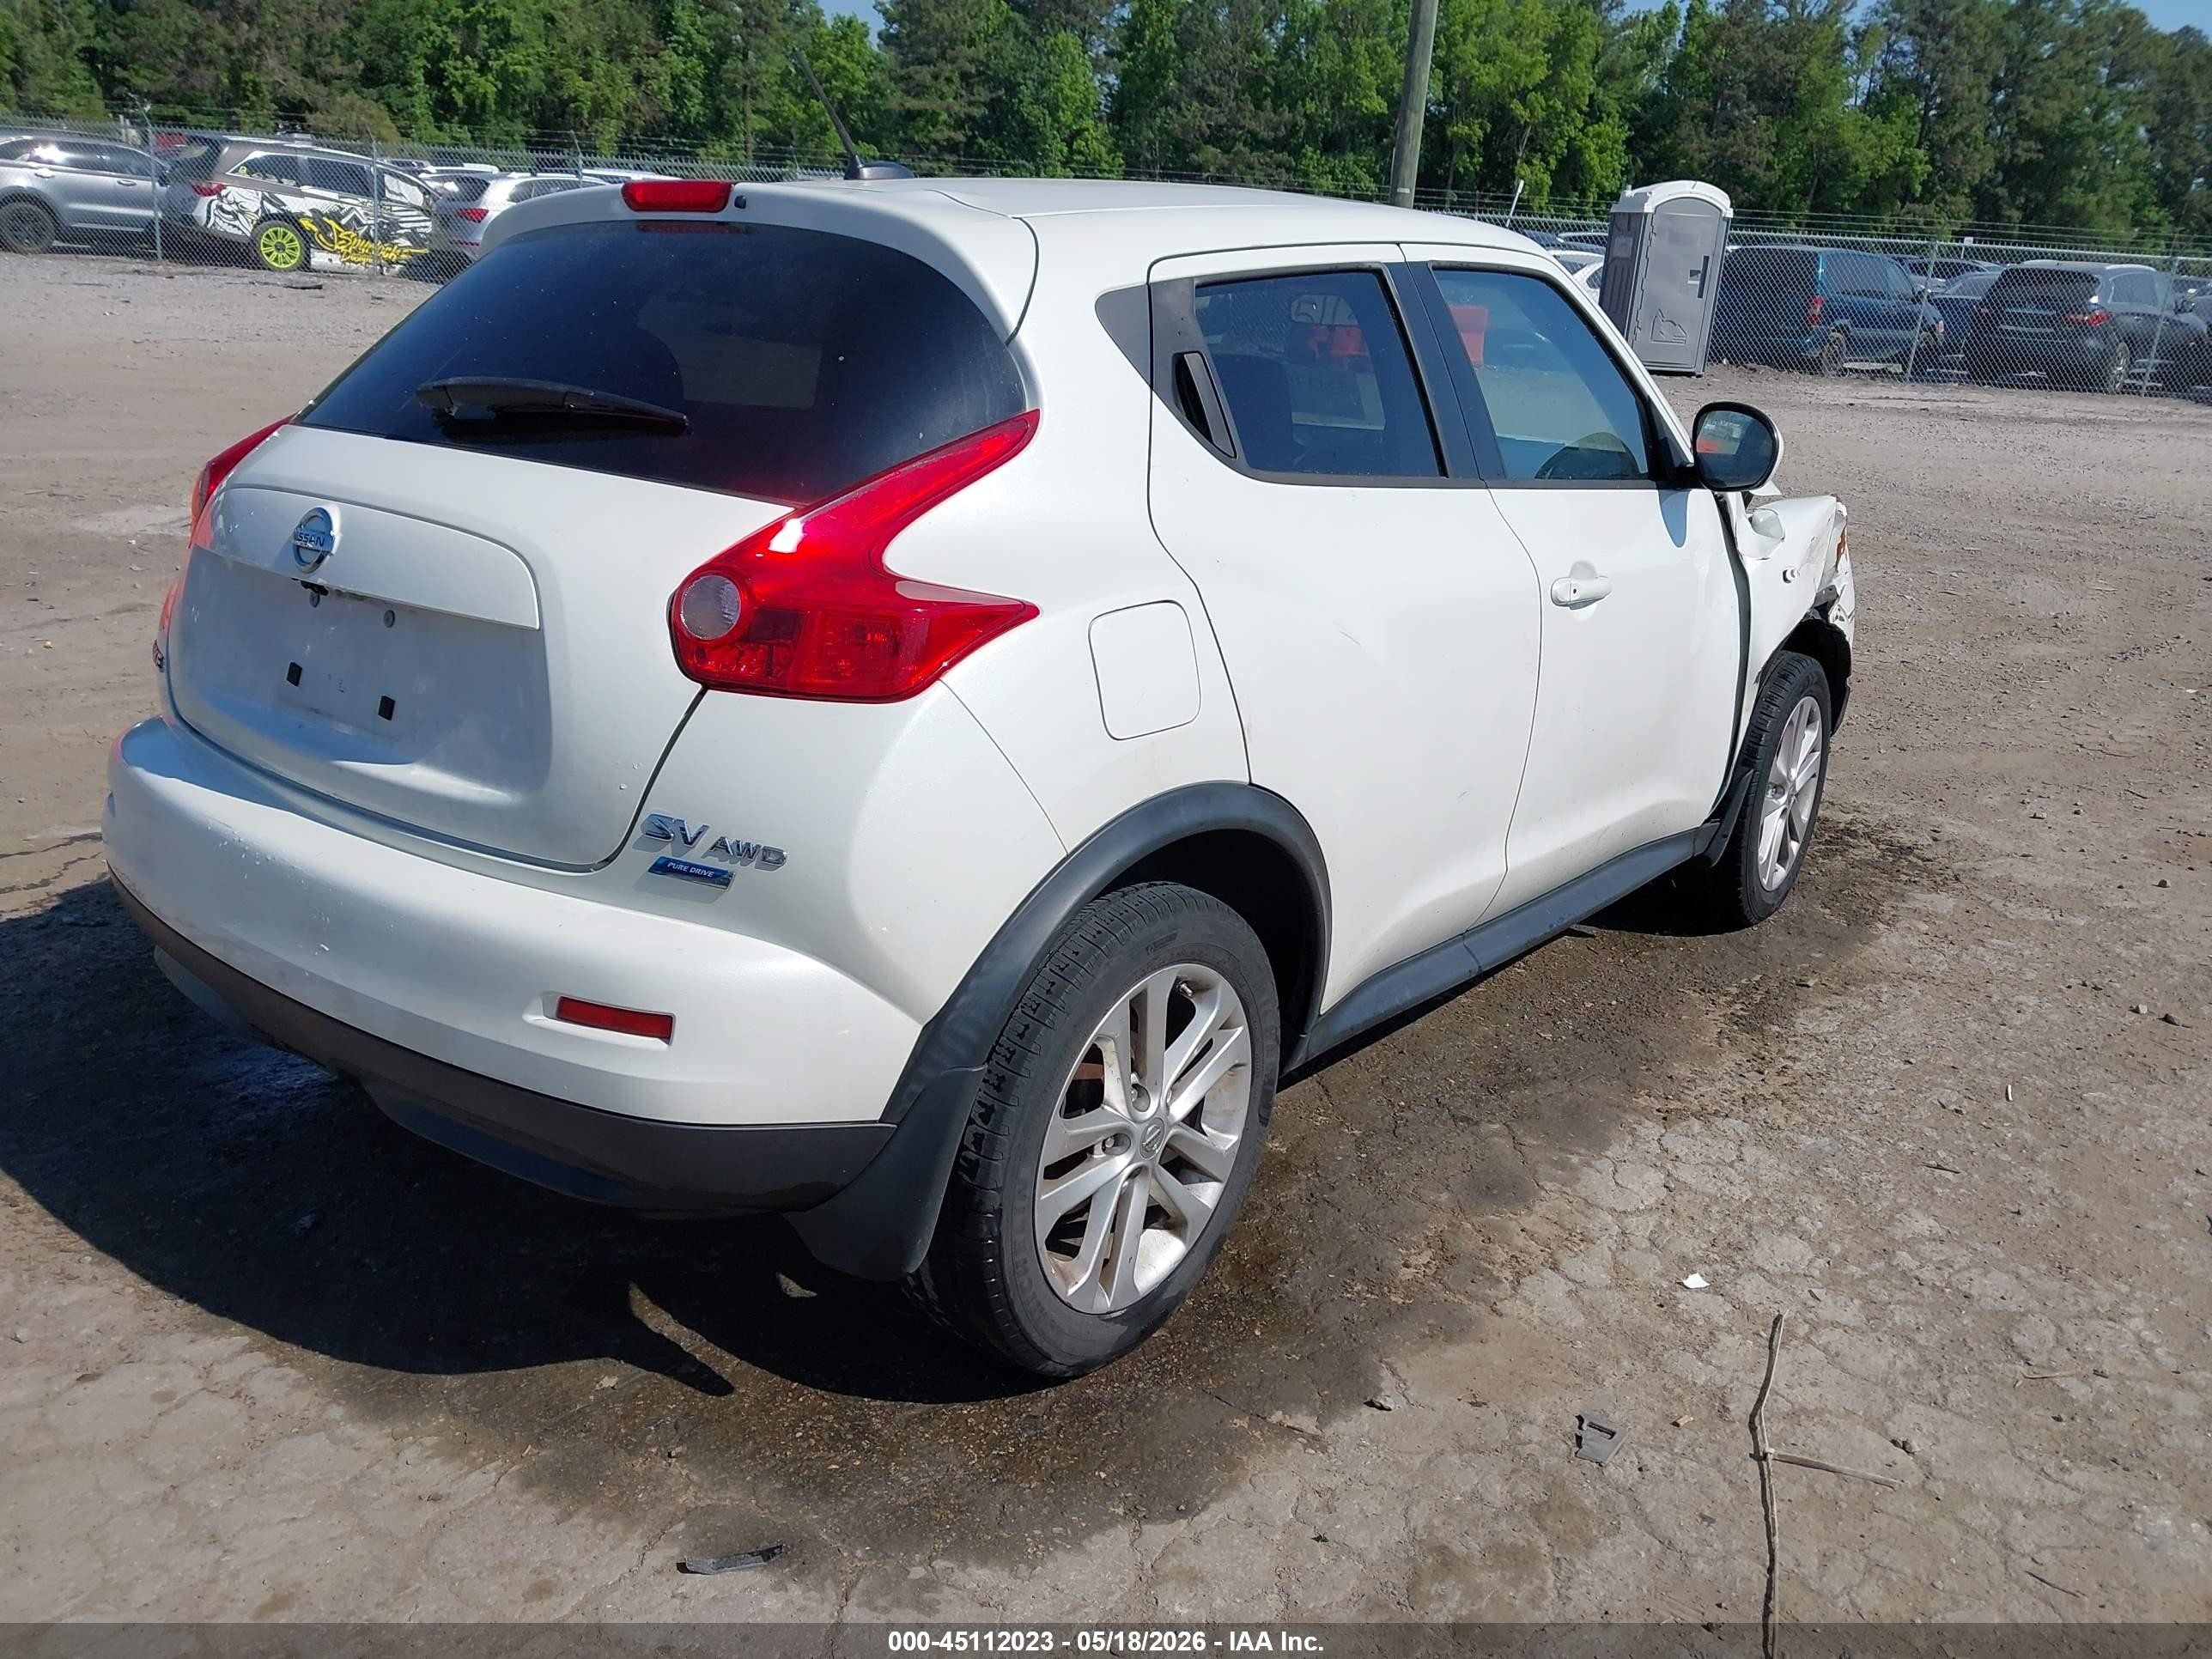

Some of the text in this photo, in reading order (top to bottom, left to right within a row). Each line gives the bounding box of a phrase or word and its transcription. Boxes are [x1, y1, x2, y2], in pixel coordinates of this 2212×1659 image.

[295, 529, 325, 547] SSAN
[642, 813, 787, 866] SV AWD
[667, 861, 714, 878] PURE DRIVE
